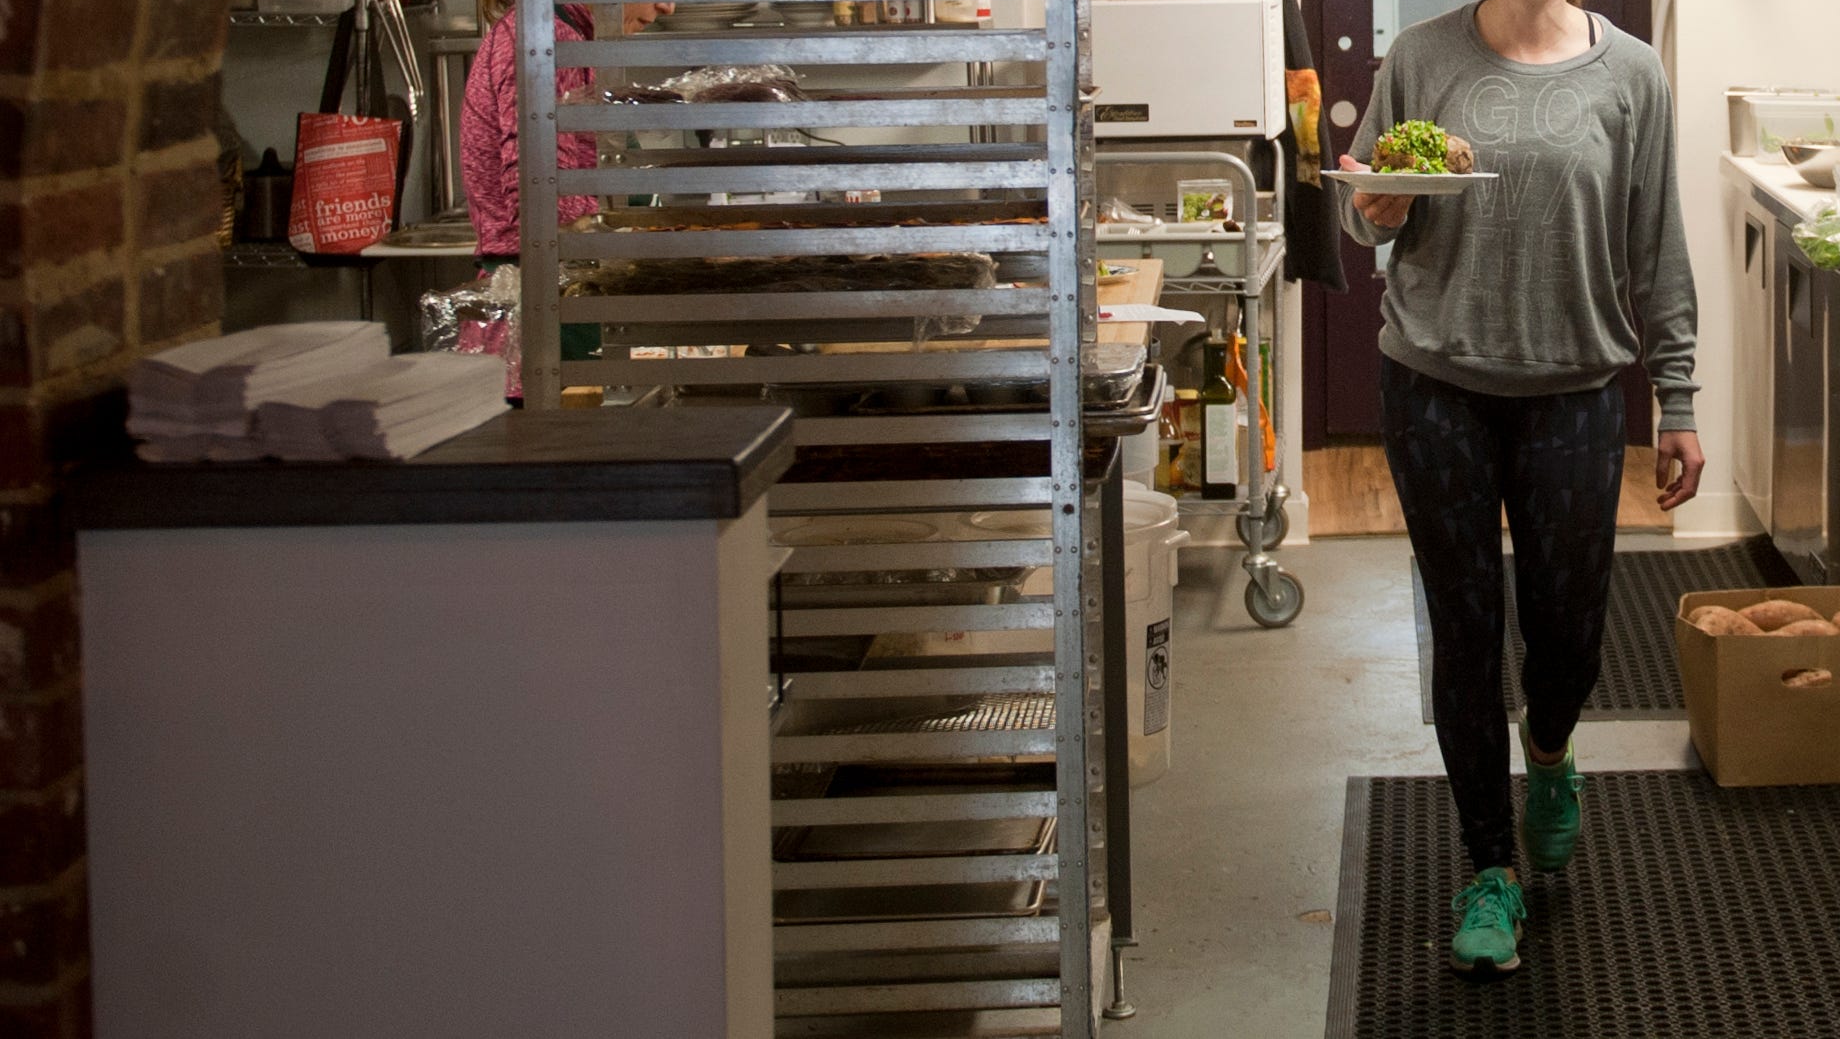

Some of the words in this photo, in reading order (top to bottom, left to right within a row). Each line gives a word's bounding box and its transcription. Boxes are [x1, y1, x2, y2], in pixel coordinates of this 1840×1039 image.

[1462, 74, 1591, 148] GO
[315, 192, 391, 218] friends
[317, 215, 341, 227] are
[345, 209, 383, 223] more
[321, 225, 380, 244] money
[1464, 226, 1576, 282] THE
